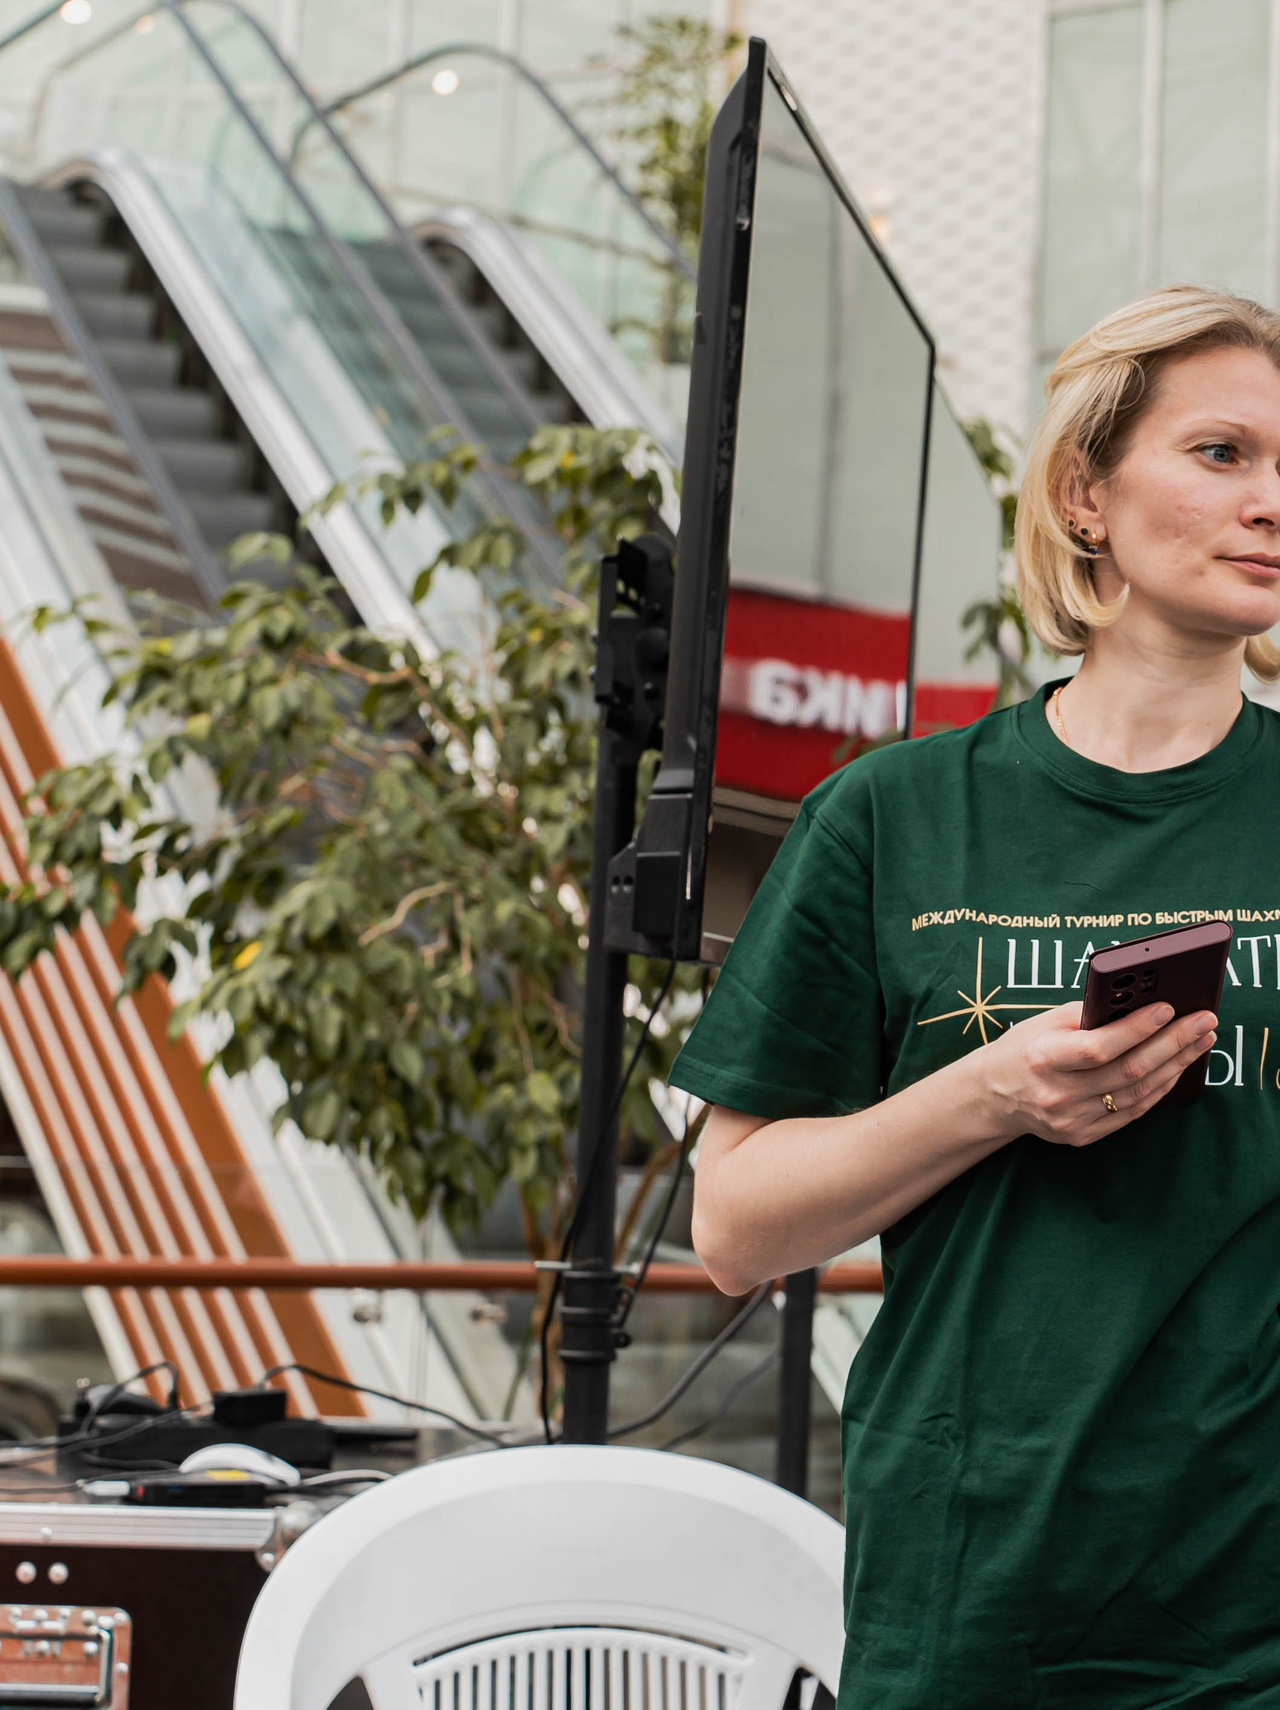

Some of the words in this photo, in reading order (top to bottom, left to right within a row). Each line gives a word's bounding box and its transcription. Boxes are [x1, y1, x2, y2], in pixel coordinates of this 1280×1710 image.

[912, 908, 1061, 931] МЕЖДУНАРОДНЫЙ
[1065, 912, 1124, 928] ТУРНИР
[1128, 912, 1152, 926] ПО
[1155, 909, 1233, 925] БЫСТРЫМ
